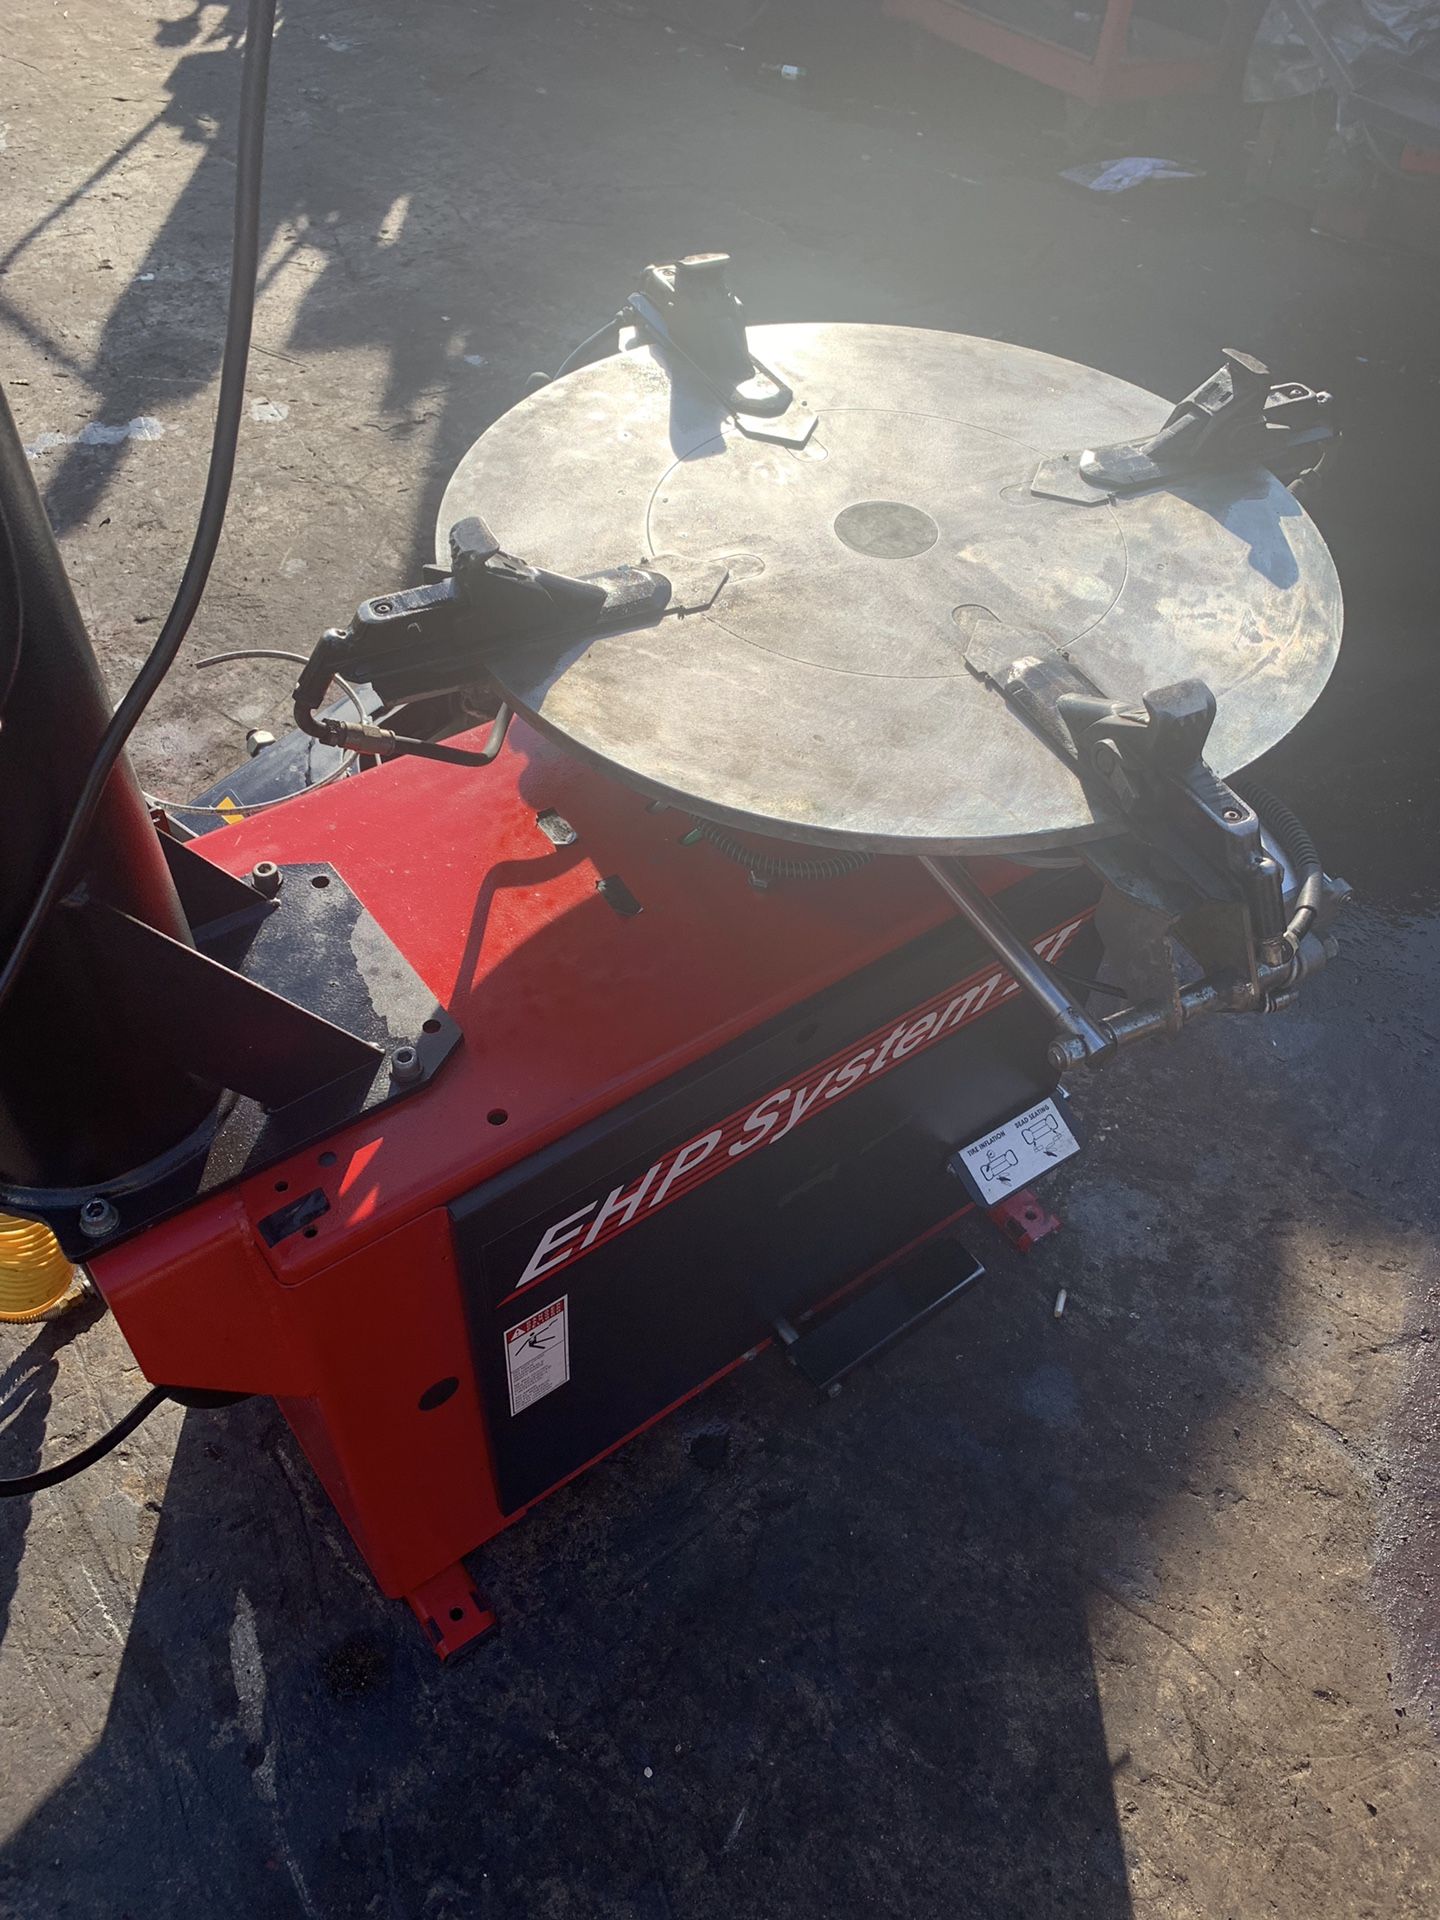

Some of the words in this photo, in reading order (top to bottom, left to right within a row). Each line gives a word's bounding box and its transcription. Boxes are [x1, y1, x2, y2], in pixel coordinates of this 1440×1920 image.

[1014, 1116, 1029, 1129] BEAD
[1029, 1104, 1050, 1120] SEATING
[515, 1129, 722, 1289] EHP
[727, 973, 1002, 1157] System
[967, 1145, 979, 1157] TIRE
[979, 1130, 1006, 1149] INFLATION
